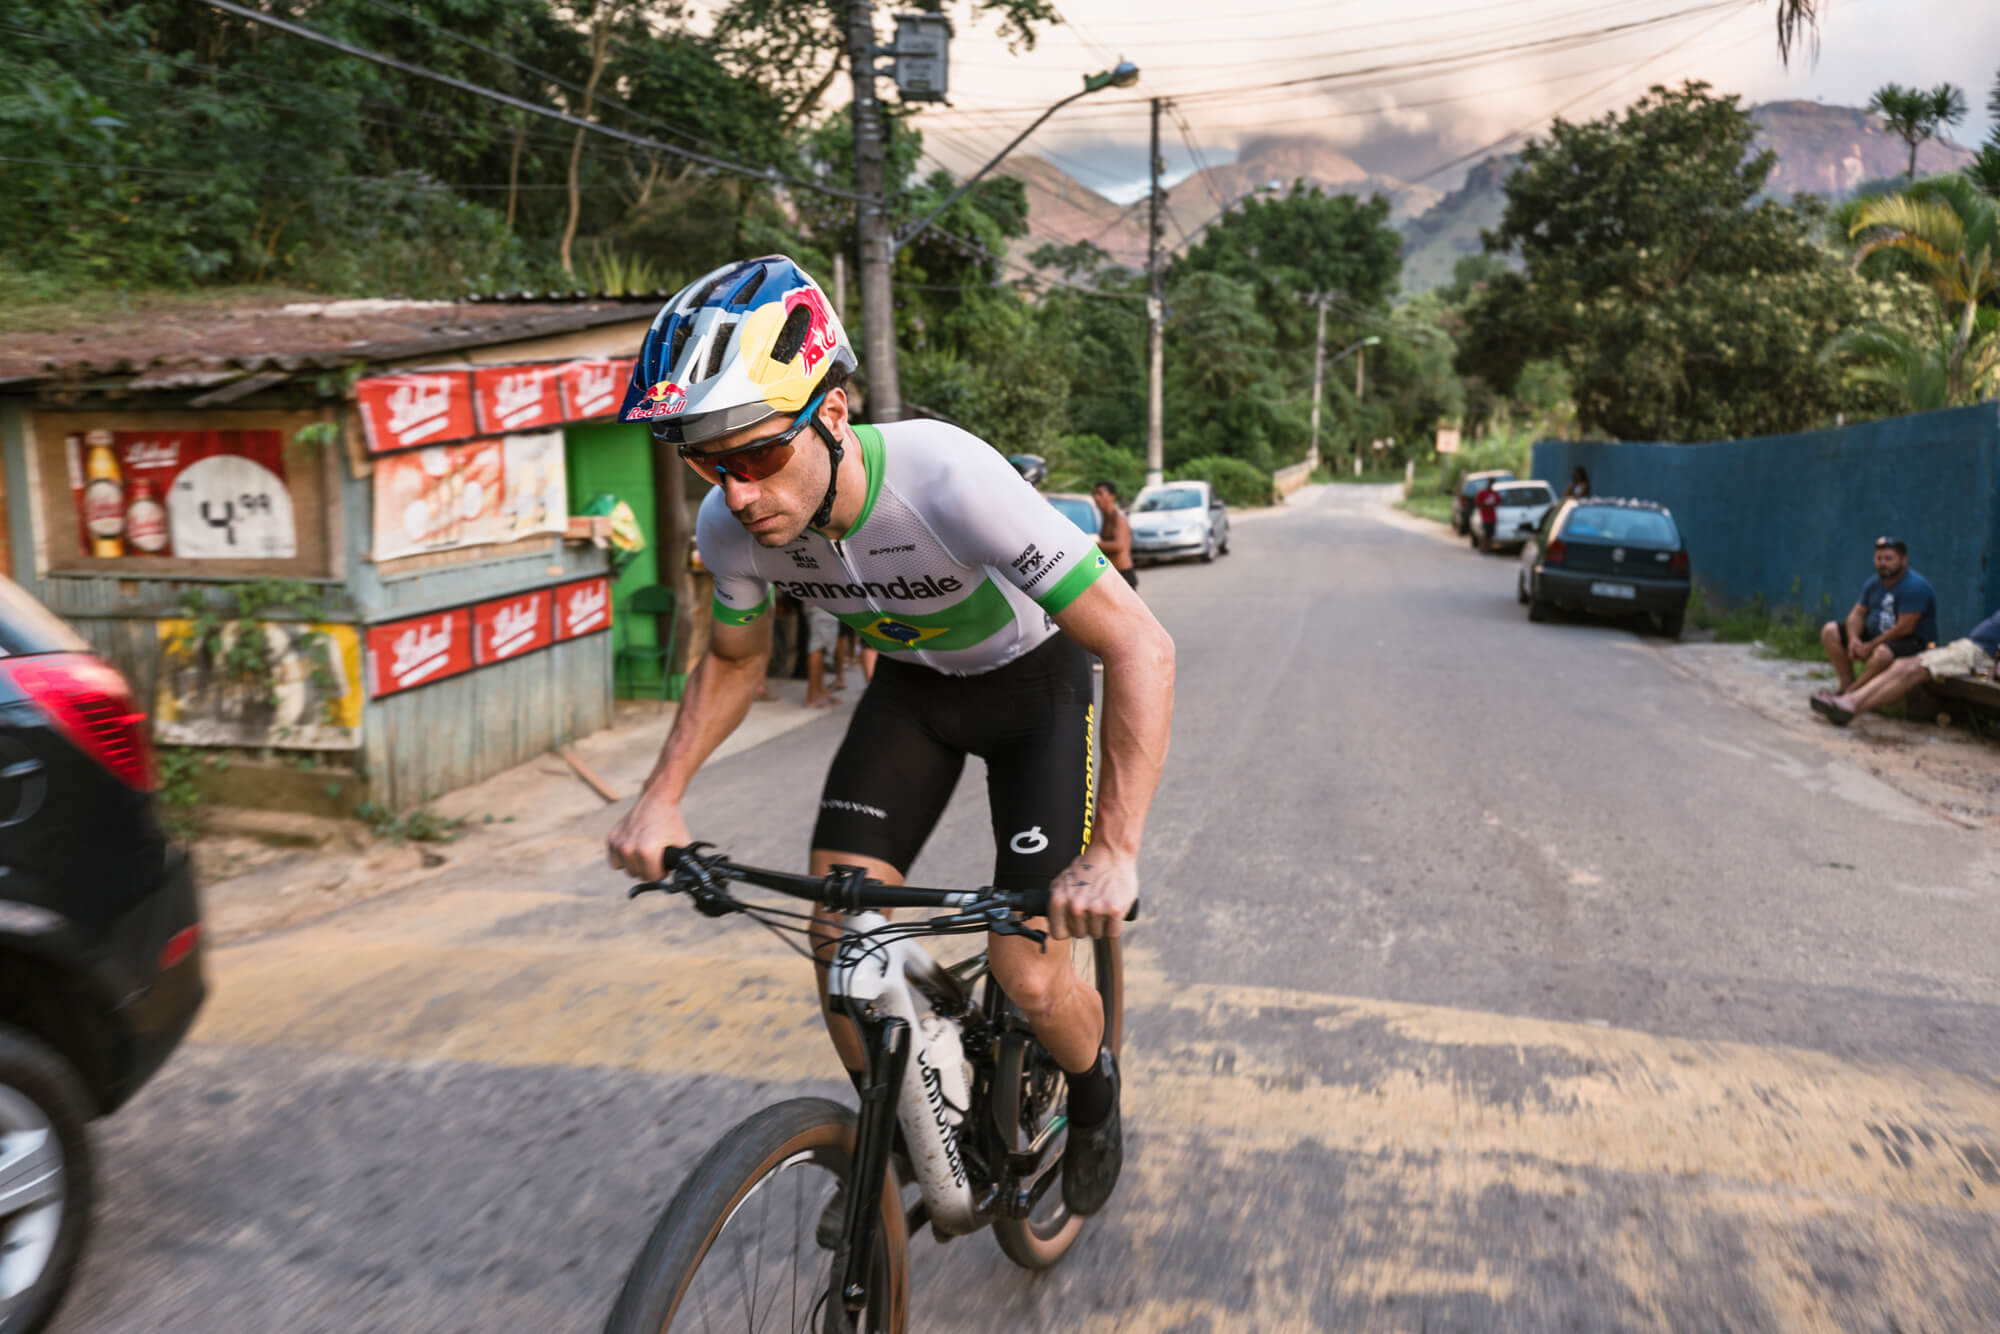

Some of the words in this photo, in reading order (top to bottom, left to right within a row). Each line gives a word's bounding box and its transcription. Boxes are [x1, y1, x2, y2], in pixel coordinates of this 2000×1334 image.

[626, 402, 657, 420] Red
[656, 400, 687, 417] Bull
[1019, 550, 1045, 576] FOX
[773, 574, 963, 601] cannondale
